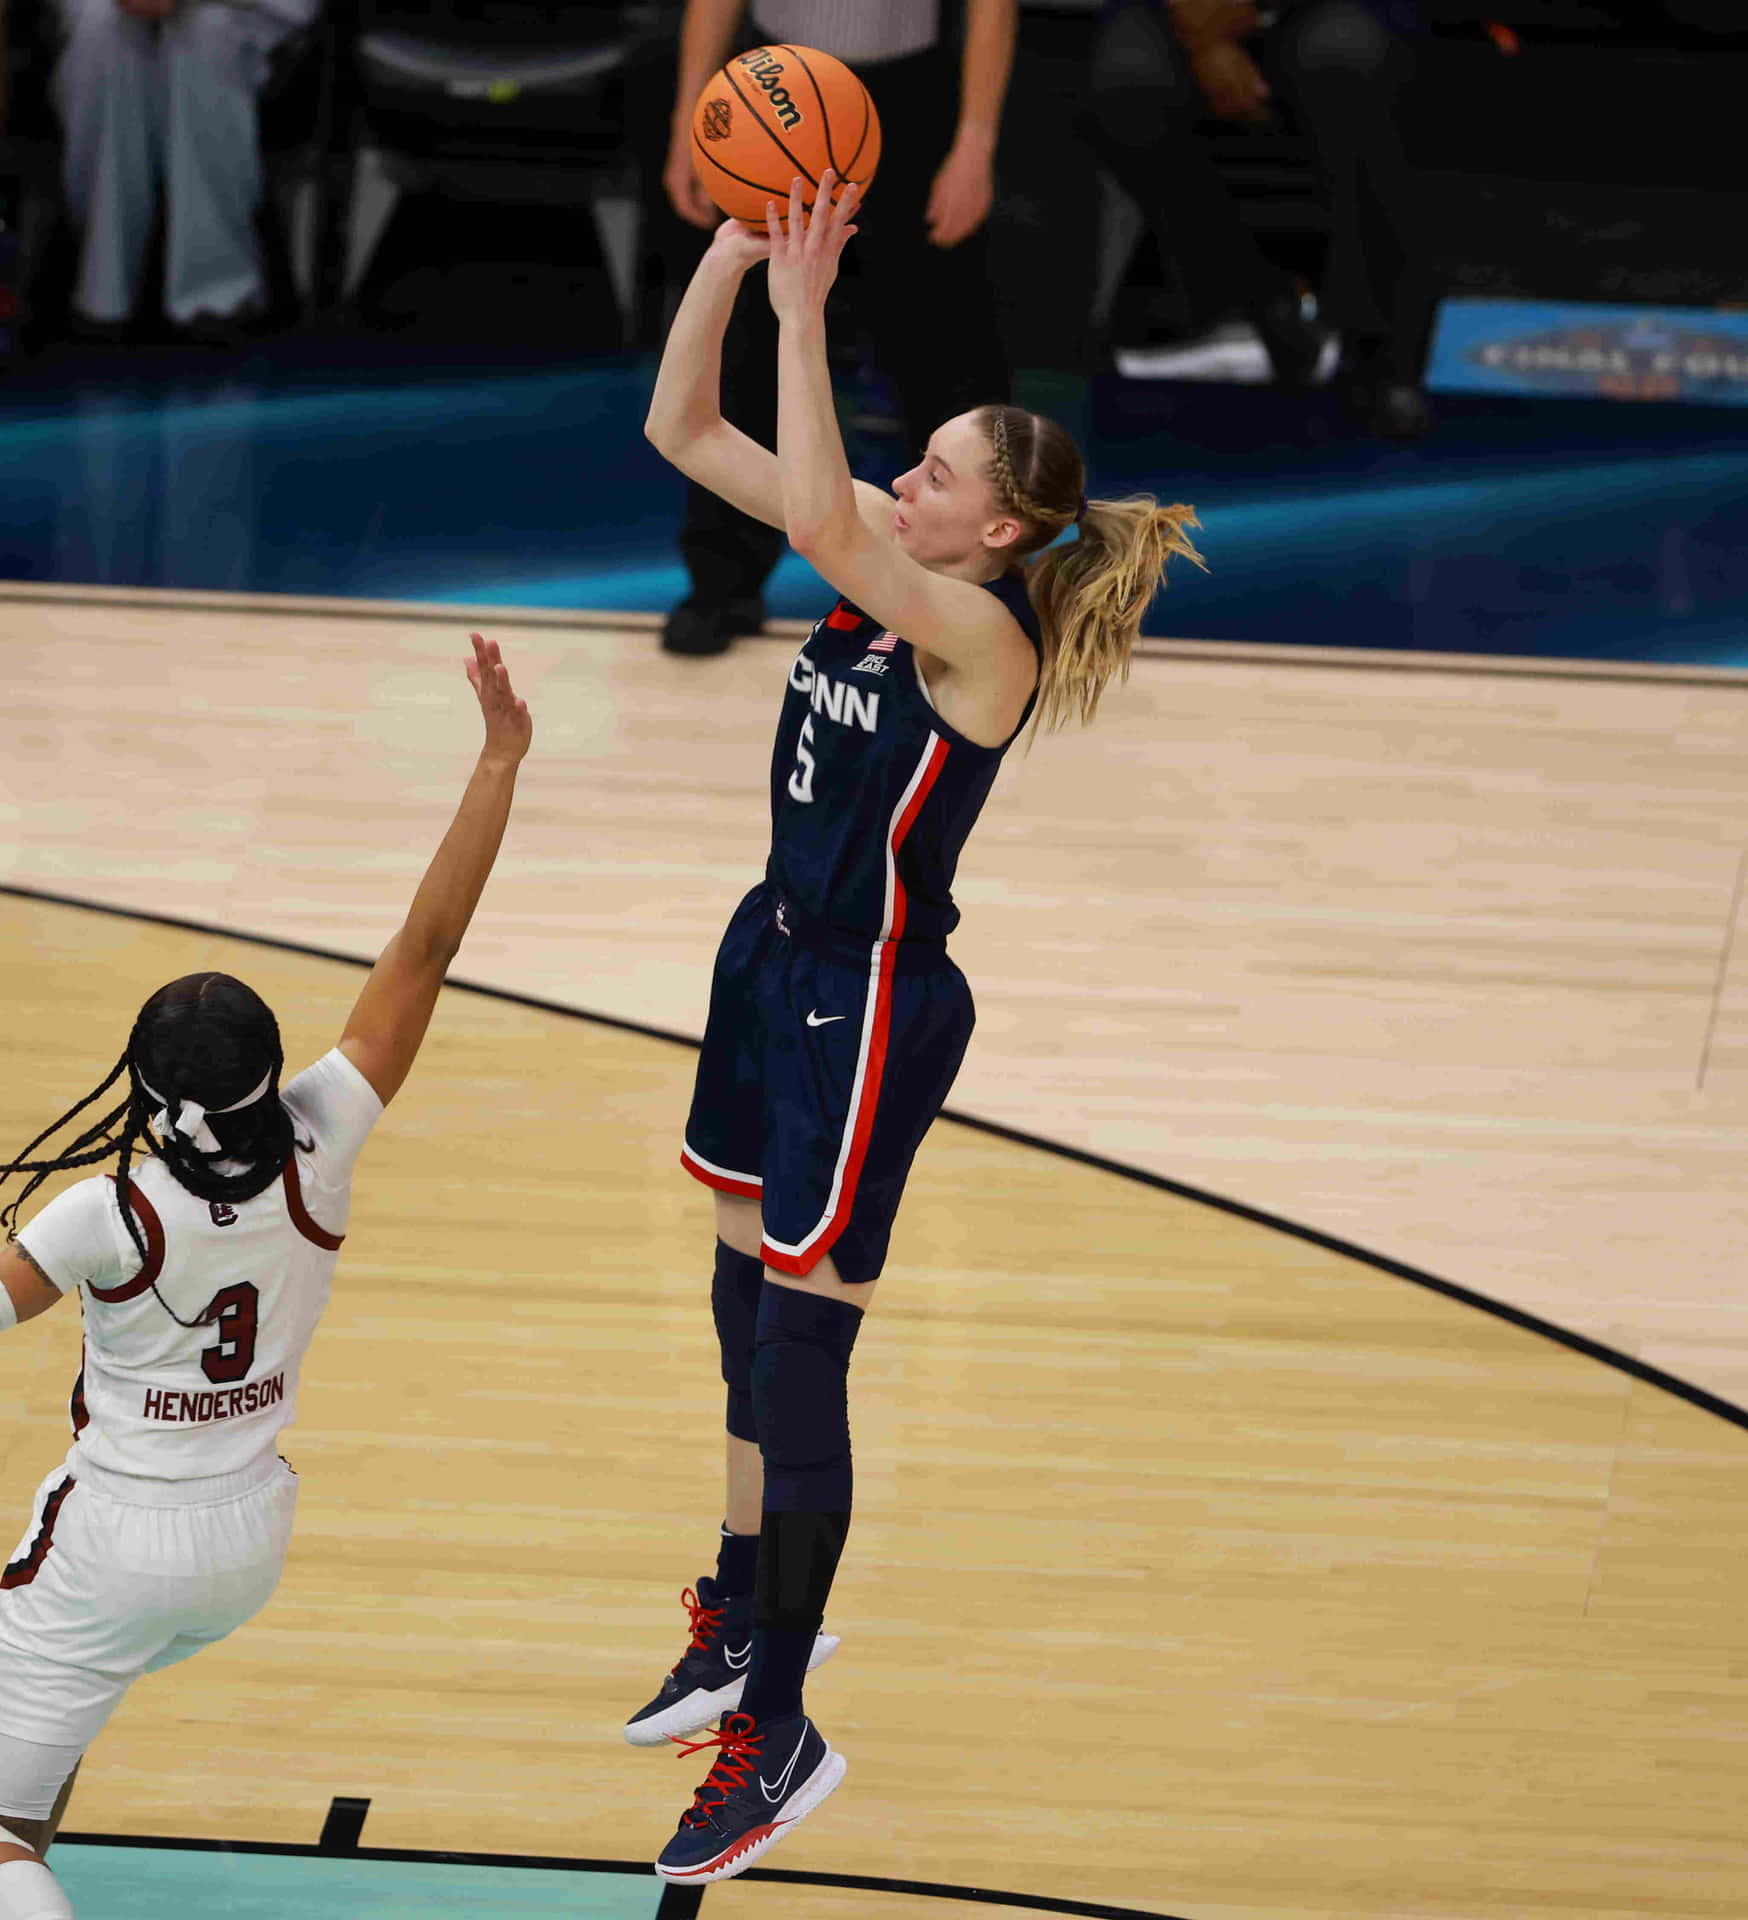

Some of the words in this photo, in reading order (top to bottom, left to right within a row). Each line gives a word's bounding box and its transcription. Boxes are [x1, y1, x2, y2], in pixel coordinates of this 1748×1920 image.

[1652, 351, 1748, 378] FOU
[855, 660, 890, 674] EAST
[863, 653, 888, 665] BIG
[788, 712, 816, 803] 5
[201, 1281, 259, 1384] 3
[143, 1371, 285, 1422] HENDERSON
